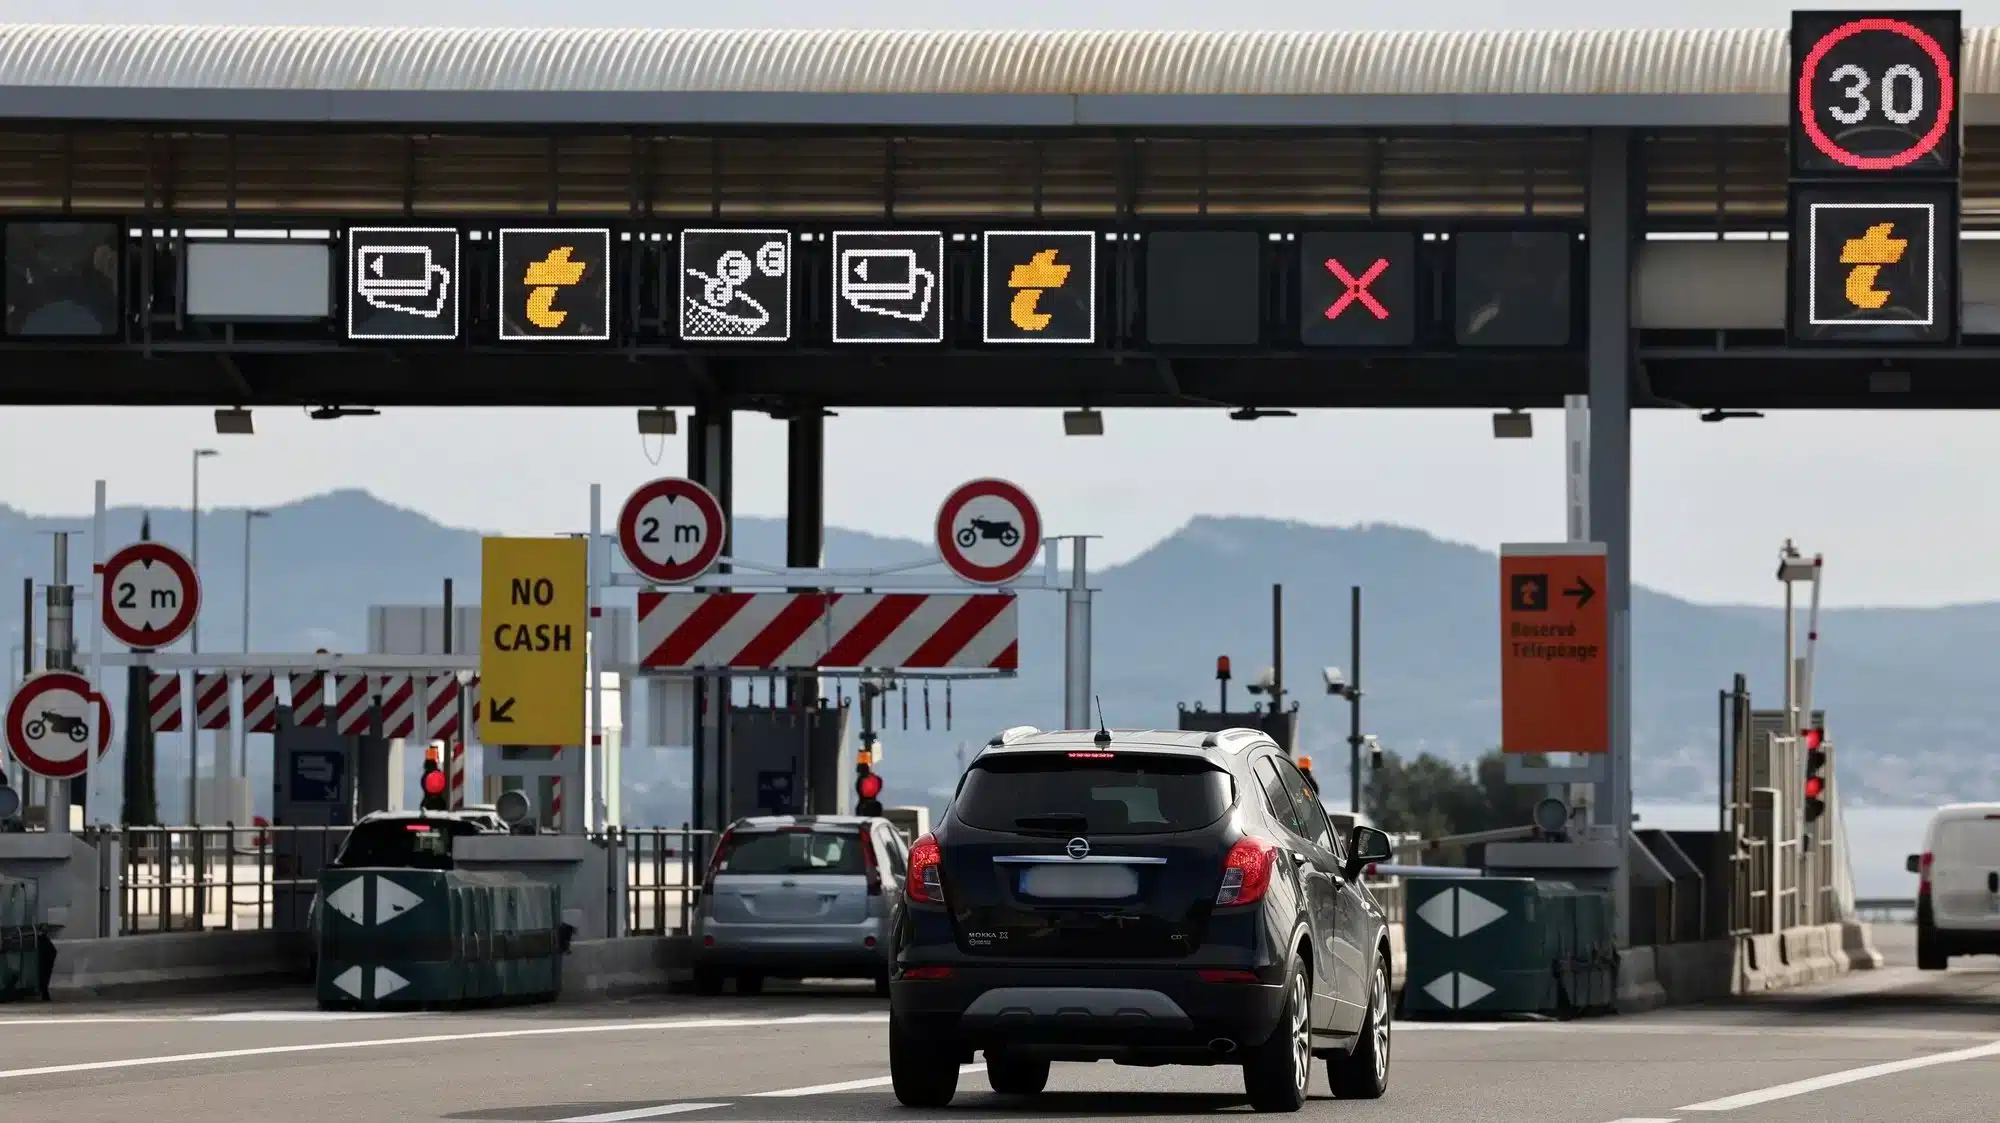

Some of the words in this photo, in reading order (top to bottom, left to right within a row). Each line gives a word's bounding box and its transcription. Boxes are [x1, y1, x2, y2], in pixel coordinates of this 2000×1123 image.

[1829, 64, 1924, 124] 30
[641, 517, 660, 543] 2
[674, 525, 700, 543] m
[118, 582, 136, 608] 2
[151, 589, 176, 608] m
[511, 578, 554, 606] NO
[494, 624, 572, 652] CASH
